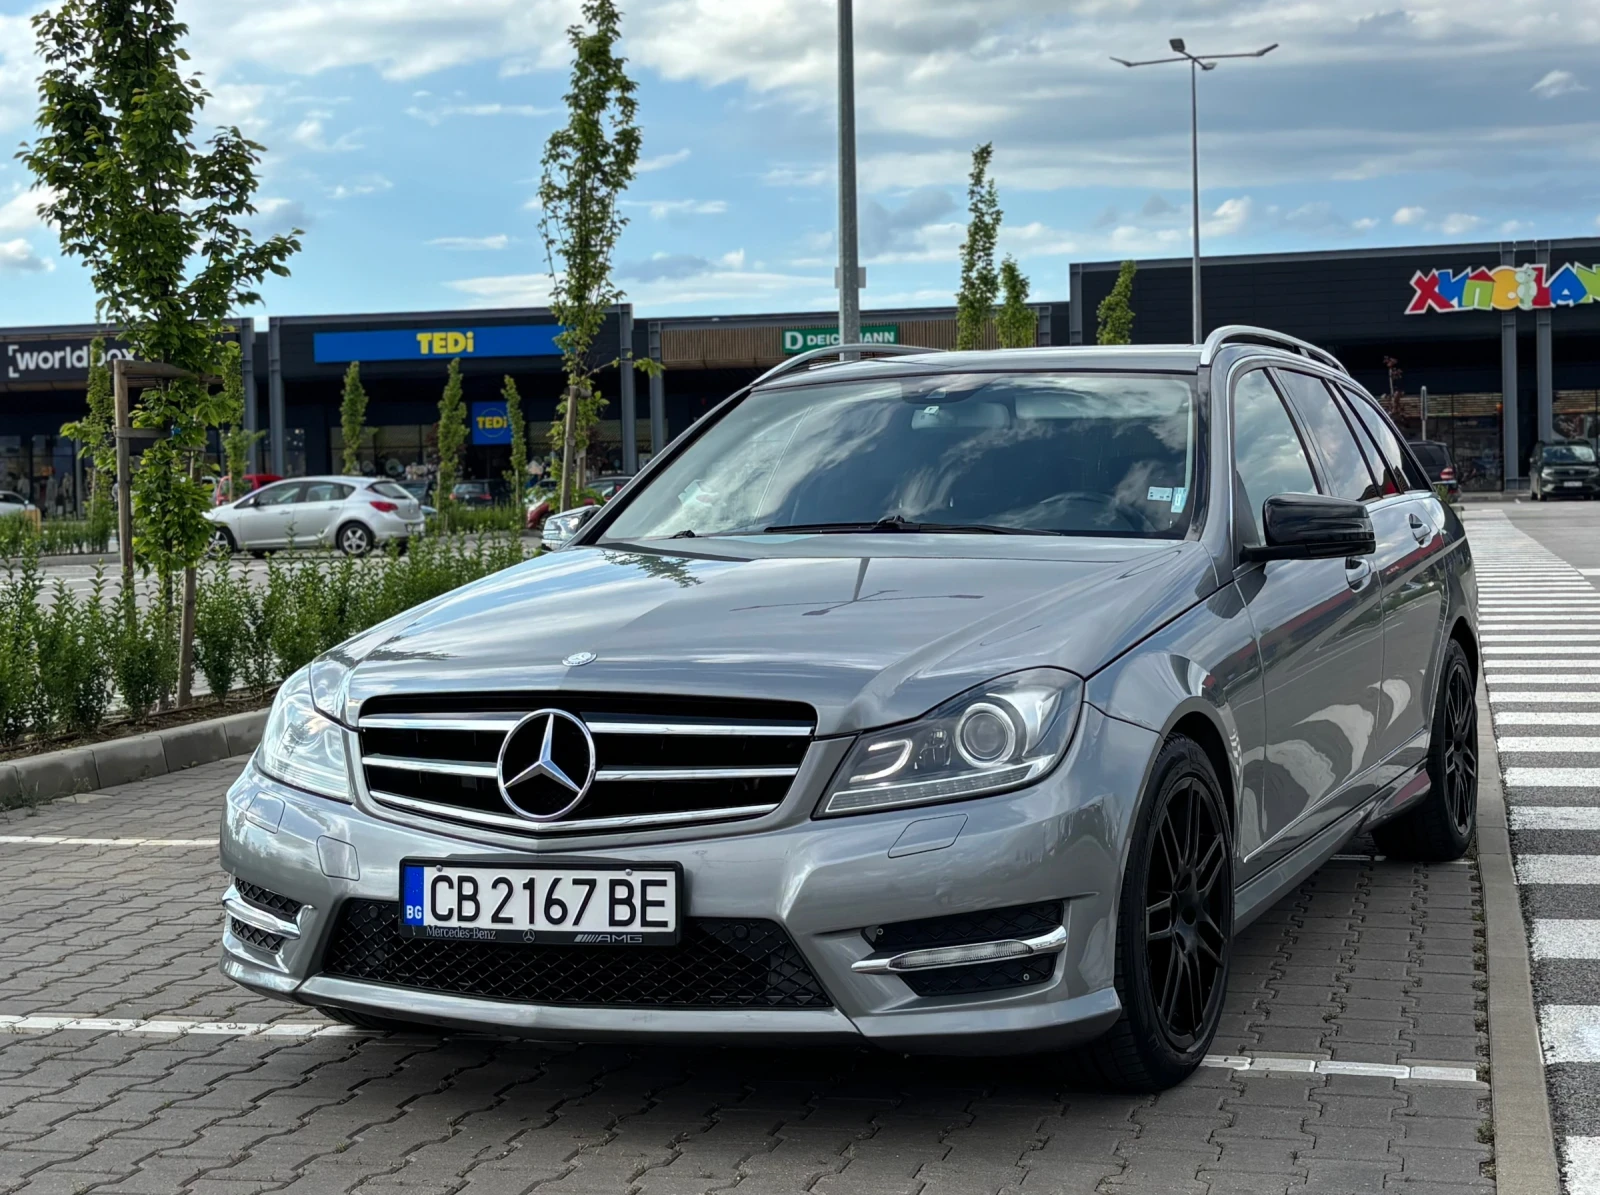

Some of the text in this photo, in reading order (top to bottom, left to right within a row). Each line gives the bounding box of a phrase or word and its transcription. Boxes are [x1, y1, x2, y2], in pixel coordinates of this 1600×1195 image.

[416, 331, 474, 354] TEDi
[784, 331, 895, 350] D DEICANN
[476, 416, 508, 429] TEDi
[430, 875, 669, 927] CB 2167 BE
[406, 905, 422, 919] BG
[426, 925, 496, 940] Mercedes-Benz
